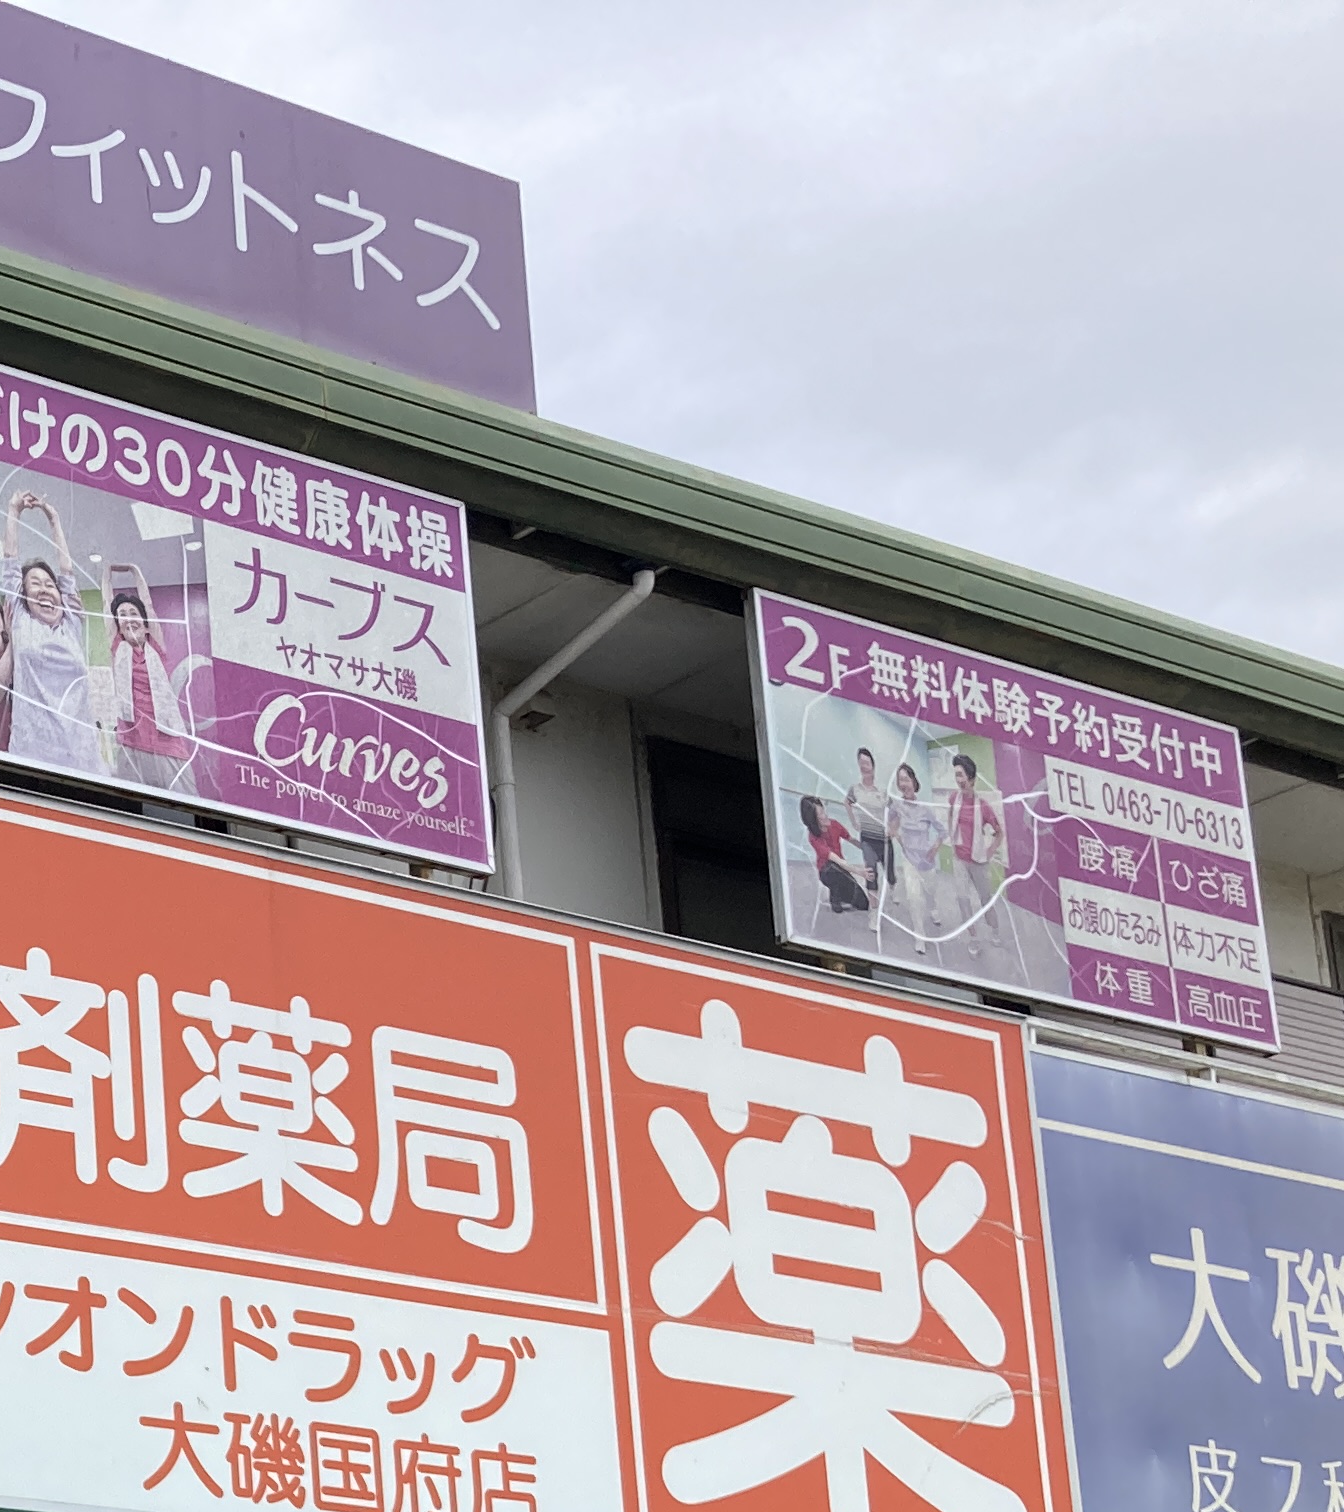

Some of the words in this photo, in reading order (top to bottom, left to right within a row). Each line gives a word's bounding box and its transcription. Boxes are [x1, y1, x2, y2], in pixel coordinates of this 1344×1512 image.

[233, 548, 450, 667] カーブス
[275, 637, 419, 704] ヤオマサ大磯
[780, 615, 850, 690] 2F
[868, 640, 1223, 788] 無料体験予約受付中
[253, 693, 449, 809] Curves
[235, 764, 270, 790] The
[330, 793, 347, 808] to
[352, 796, 401, 821] amaze
[1052, 768, 1097, 812] TEL
[1102, 782, 1245, 851] 0463-70-6313
[1077, 833, 1139, 883] 腰痛
[1168, 857, 1248, 909] ひざ痛
[1067, 893, 1162, 949] お腹のたるみ
[1172, 921, 1262, 976] 体力不足
[1094, 960, 1155, 1007] 体重
[1186, 984, 1266, 1034] 高血圧
